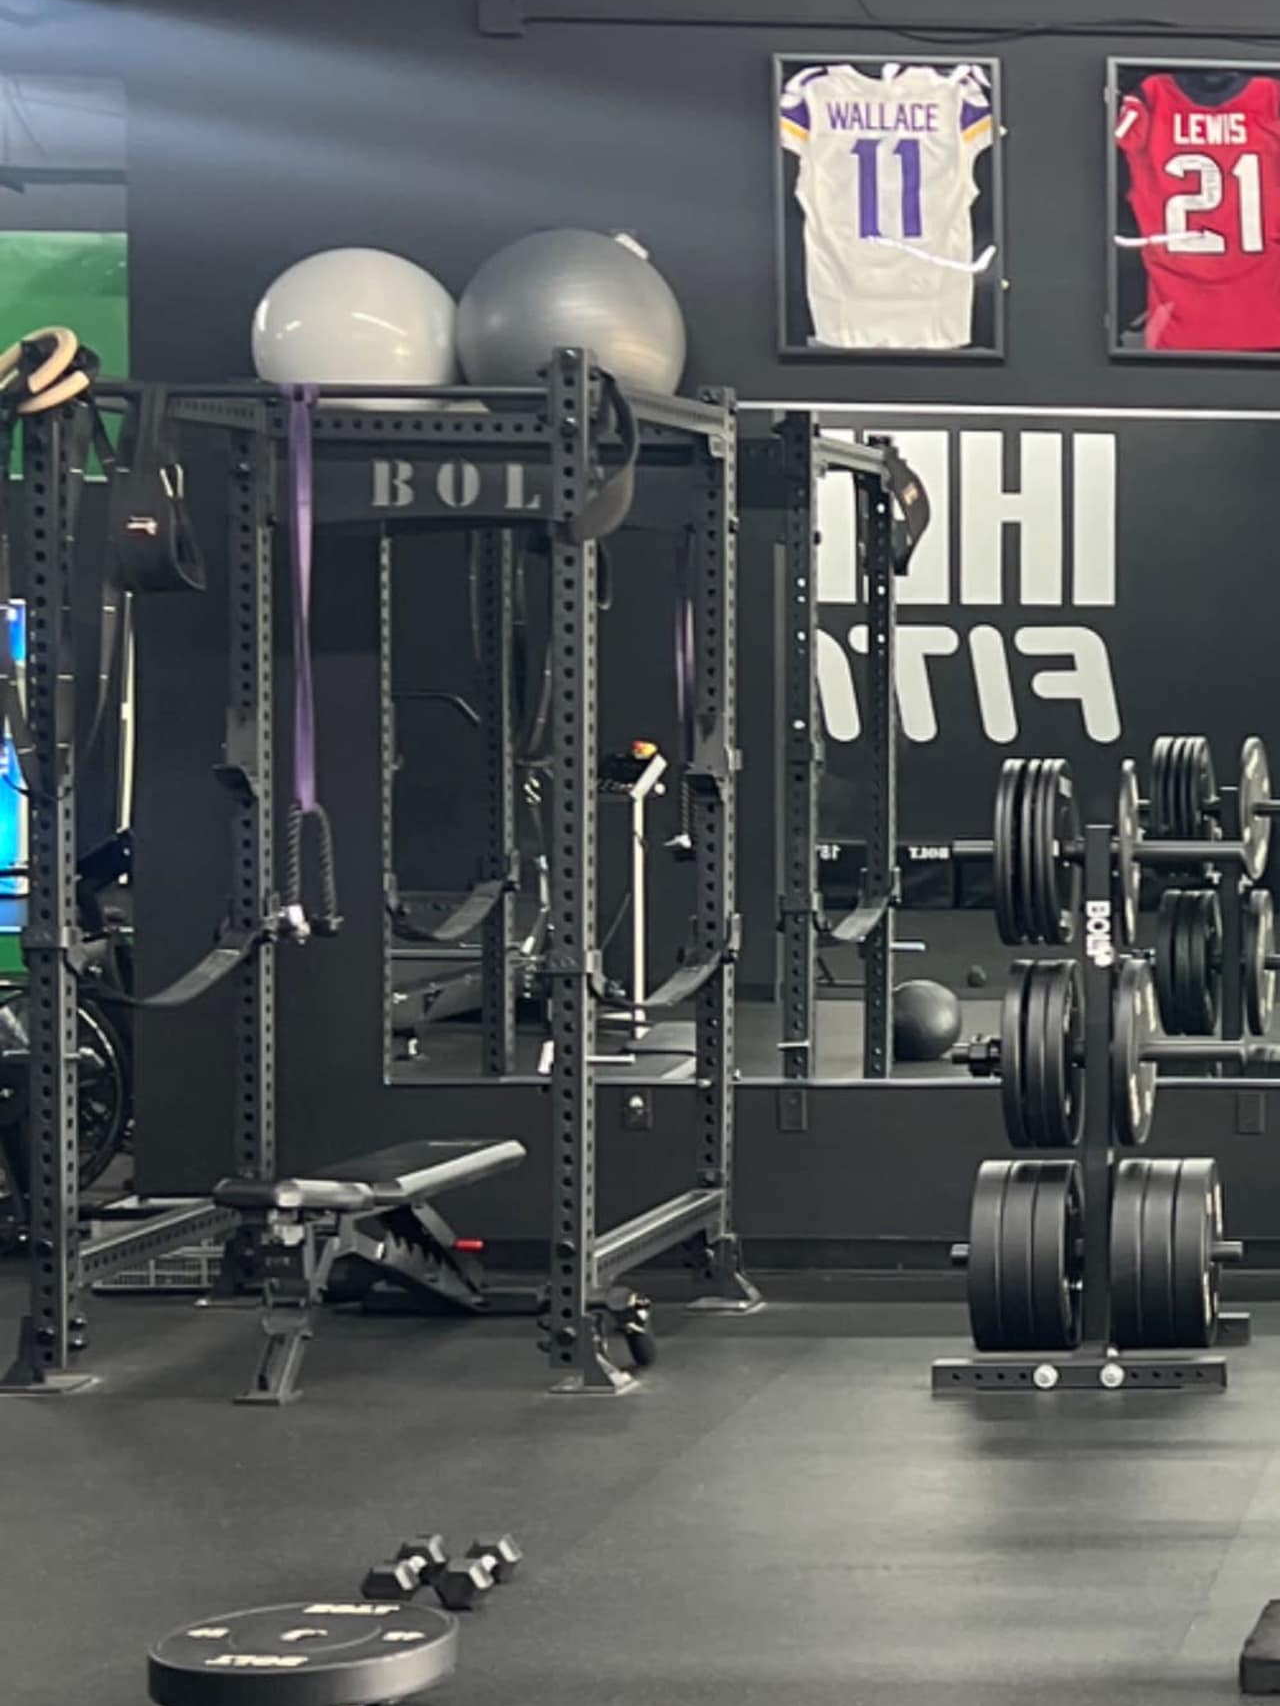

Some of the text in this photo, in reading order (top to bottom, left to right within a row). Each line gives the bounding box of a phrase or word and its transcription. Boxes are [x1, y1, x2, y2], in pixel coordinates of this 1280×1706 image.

[826, 101, 941, 134] WALLACE
[1173, 110, 1248, 147] LEWIS
[850, 138, 923, 240] 11
[1163, 153, 1264, 254] 21
[371, 458, 541, 509] BOL
